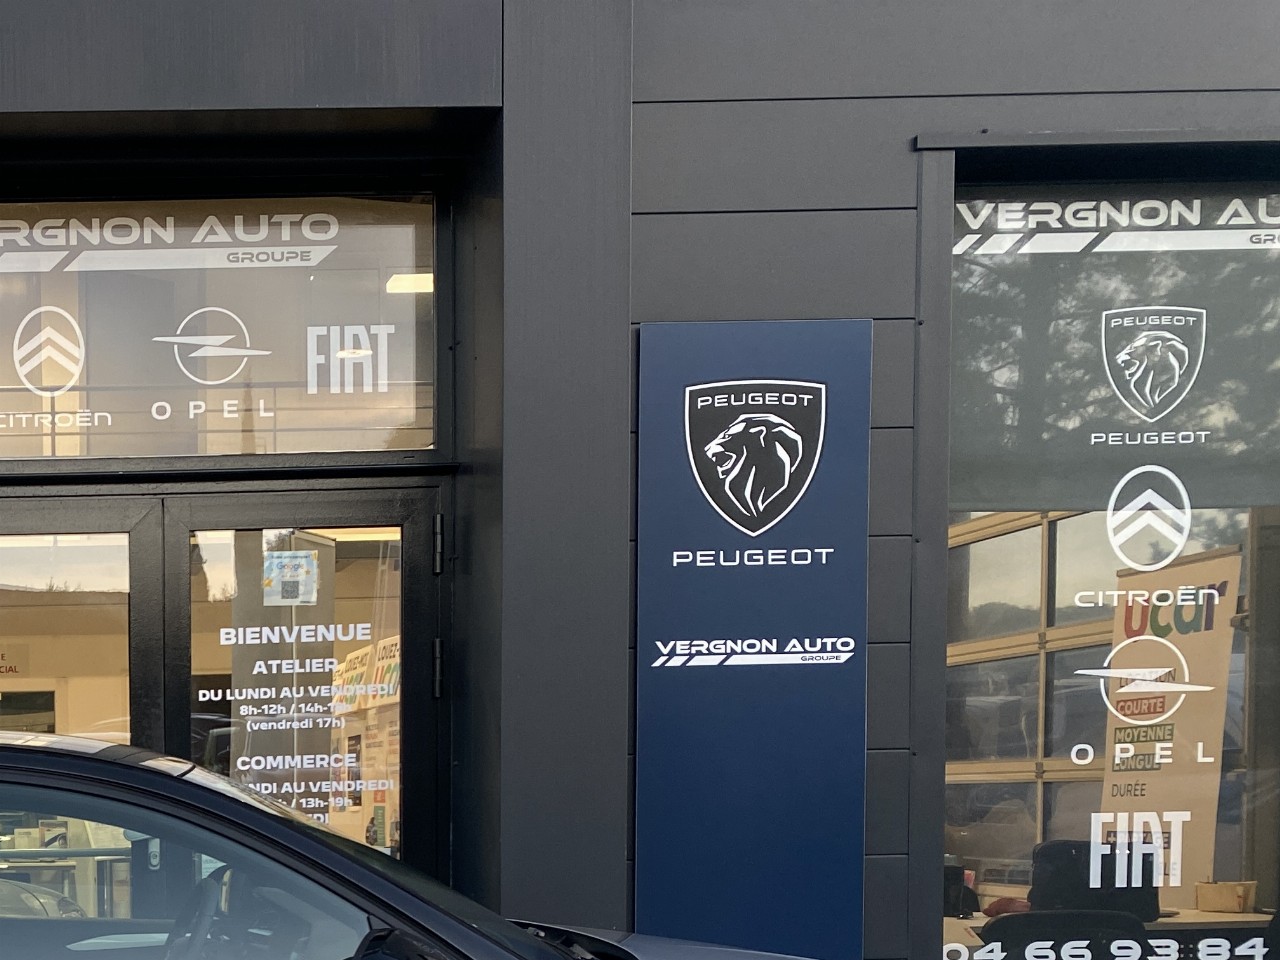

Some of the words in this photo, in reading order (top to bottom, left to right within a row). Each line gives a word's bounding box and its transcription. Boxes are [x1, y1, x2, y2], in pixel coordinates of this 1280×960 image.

[956, 199, 1201, 230] VERGNON
[190, 213, 340, 244] AUTO
[1249, 234, 1280, 244] GR
[227, 250, 312, 263] GROUPE
[1110, 316, 1197, 328] PEUGEOT
[307, 325, 395, 395] FIAT
[697, 393, 813, 409] PEUGEOT
[1091, 431, 1211, 445] PEUGEOT
[673, 548, 834, 567] PEUGEOT
[1074, 586, 1219, 607] CITROËN
[219, 623, 371, 646] BIENVENUE
[655, 638, 777, 654] VERGNON
[784, 637, 855, 652] AUTO
[252, 658, 338, 675] ATELIER
[198, 689, 222, 702] DU
[226, 687, 276, 701] LUNDI
[280, 686, 304, 699] AU
[308, 683, 394, 698] VENDREDI
[239, 703, 287, 716] 8h-12h
[1117, 697, 1164, 715] COURTE
[246, 717, 313, 732] (vendredi
[316, 717, 346, 729] 17h)
[1115, 725, 1172, 743] MOYENNE
[236, 753, 357, 771] COMMERCE
[281, 781, 305, 794] AU
[309, 779, 394, 793] VENDREDI
[1111, 780, 1147, 797] DURÉE
[299, 797, 353, 808] 13h-19h
[1089, 811, 1191, 888] FIAT
